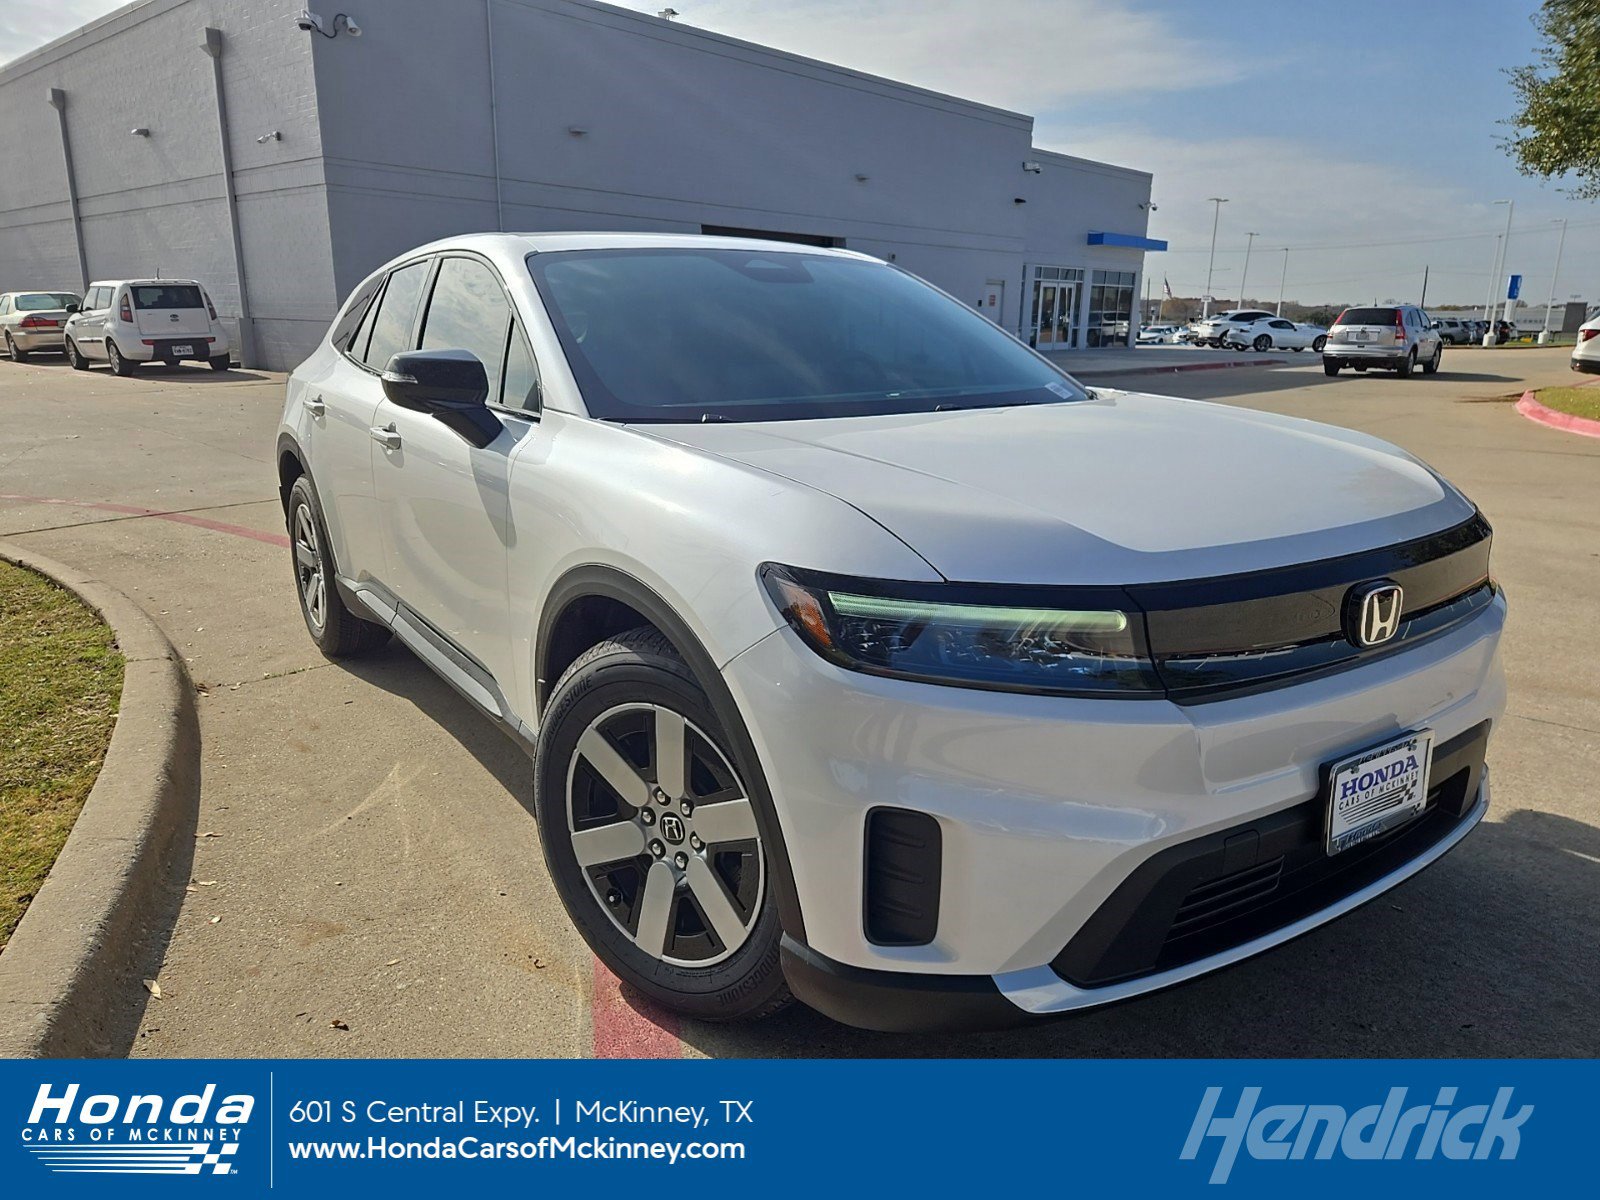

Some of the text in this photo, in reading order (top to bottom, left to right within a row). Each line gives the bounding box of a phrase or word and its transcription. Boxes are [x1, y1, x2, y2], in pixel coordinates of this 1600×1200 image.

[1340, 755, 1419, 800] HONDA
[1339, 795, 1360, 810] CARS
[1365, 789, 1376, 799] OF
